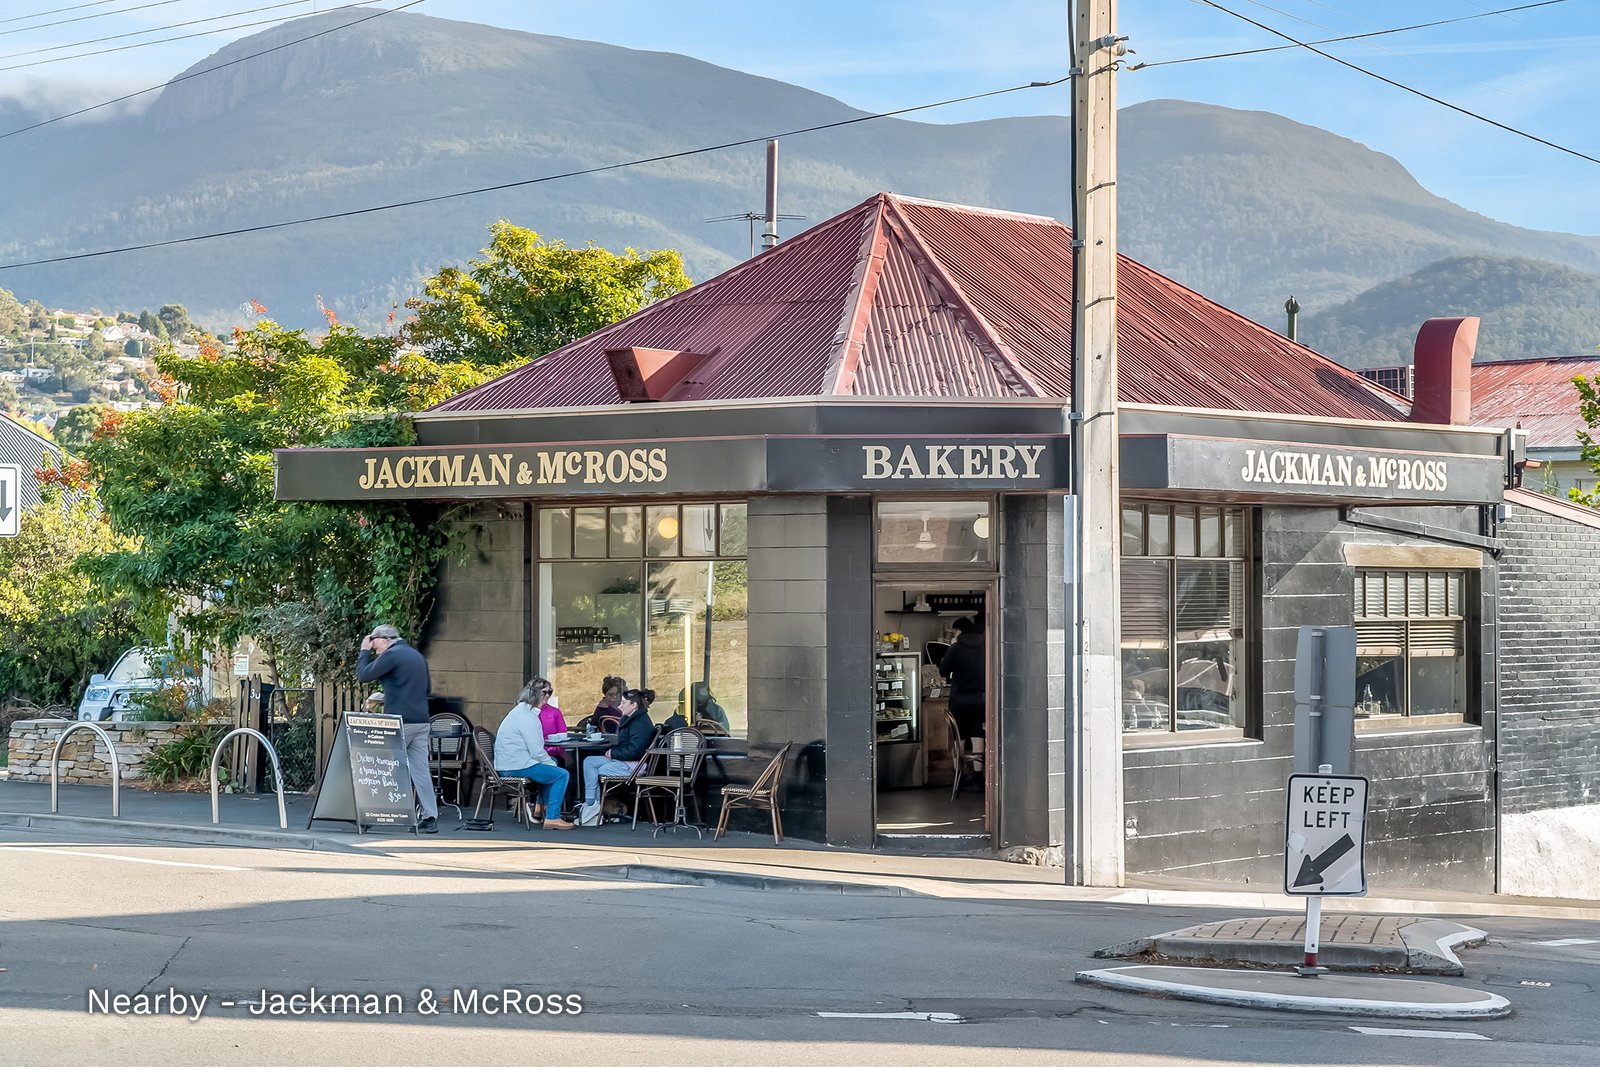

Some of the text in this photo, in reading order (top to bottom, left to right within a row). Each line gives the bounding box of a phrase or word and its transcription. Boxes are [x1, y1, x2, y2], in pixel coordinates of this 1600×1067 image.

[359, 448, 668, 489] JACKMAN & McROSS
[862, 444, 1046, 479] BAKERY
[1241, 450, 1448, 491] JACKMAN & McROSS
[1303, 786, 1355, 804] KEEP
[1304, 811, 1351, 828] LEFT
